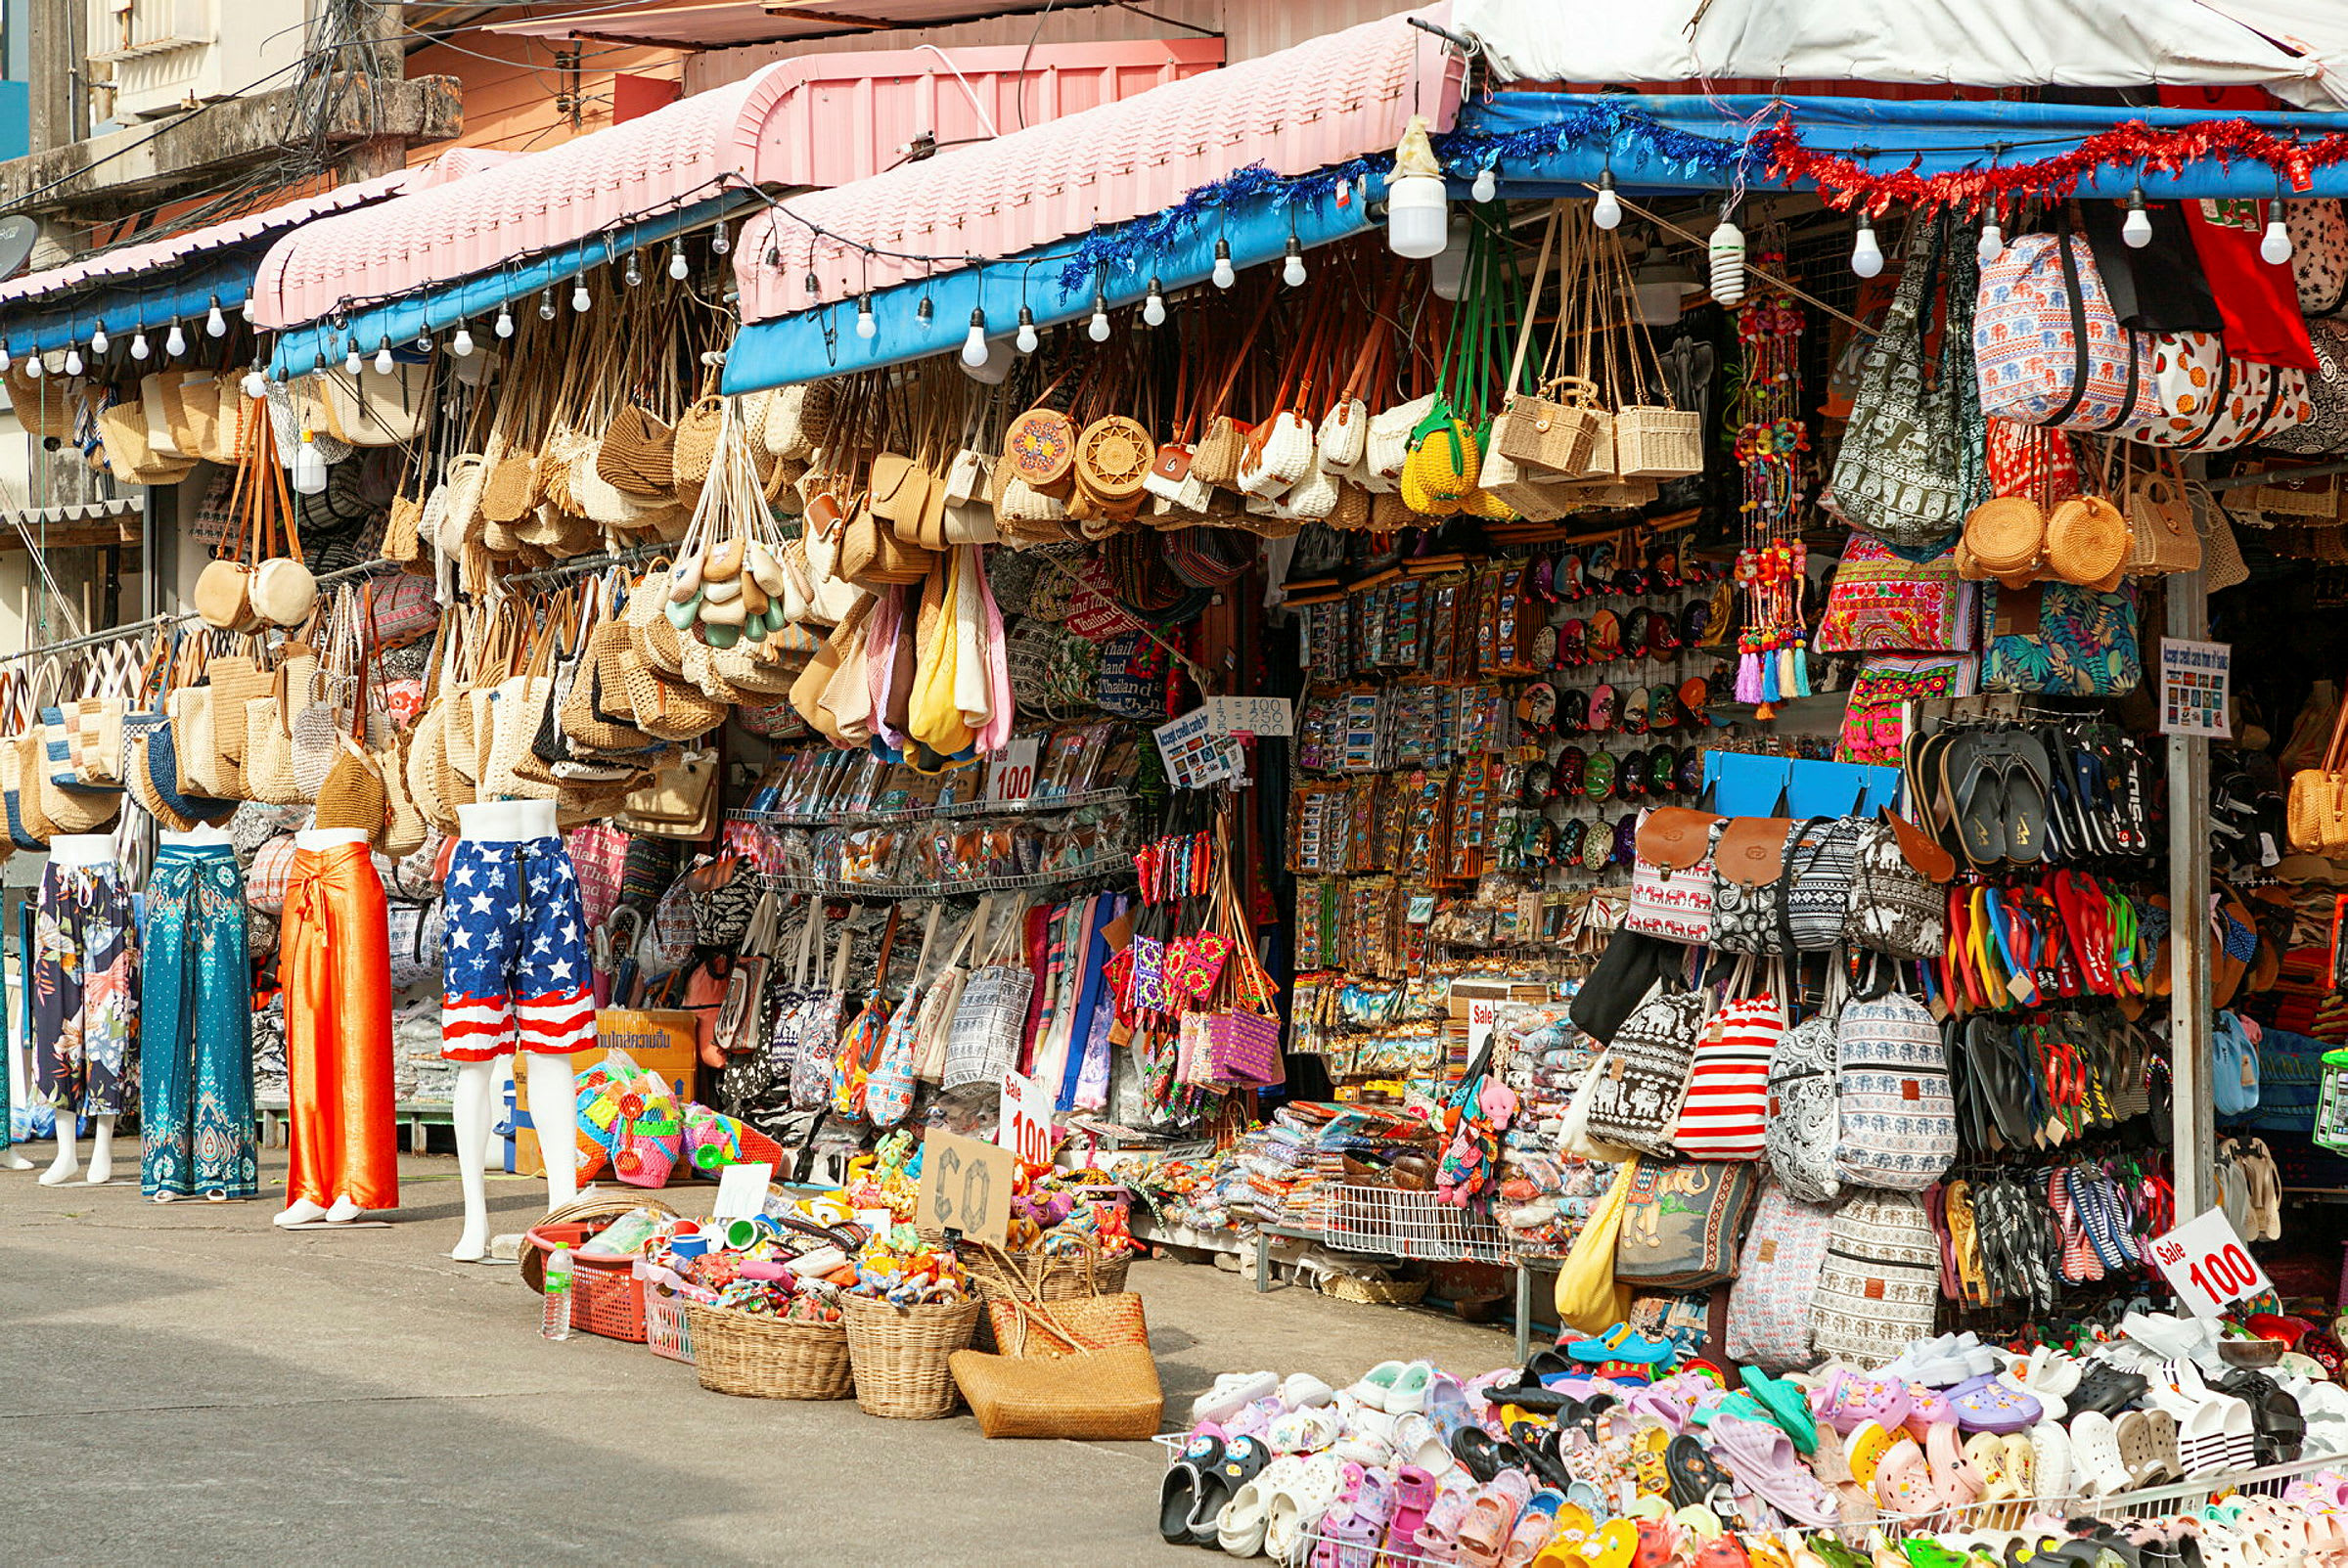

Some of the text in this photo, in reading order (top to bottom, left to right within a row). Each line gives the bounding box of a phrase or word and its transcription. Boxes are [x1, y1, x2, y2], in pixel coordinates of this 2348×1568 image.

[1249, 698, 1281, 712] 100
[1249, 711, 1284, 724] 250
[997, 764, 1031, 800] 100
[1473, 1004, 1493, 1025] Sale
[1005, 1074, 1021, 1102] Sale
[2155, 1240, 2187, 1266] Sale
[2190, 1243, 2257, 1305] 100
